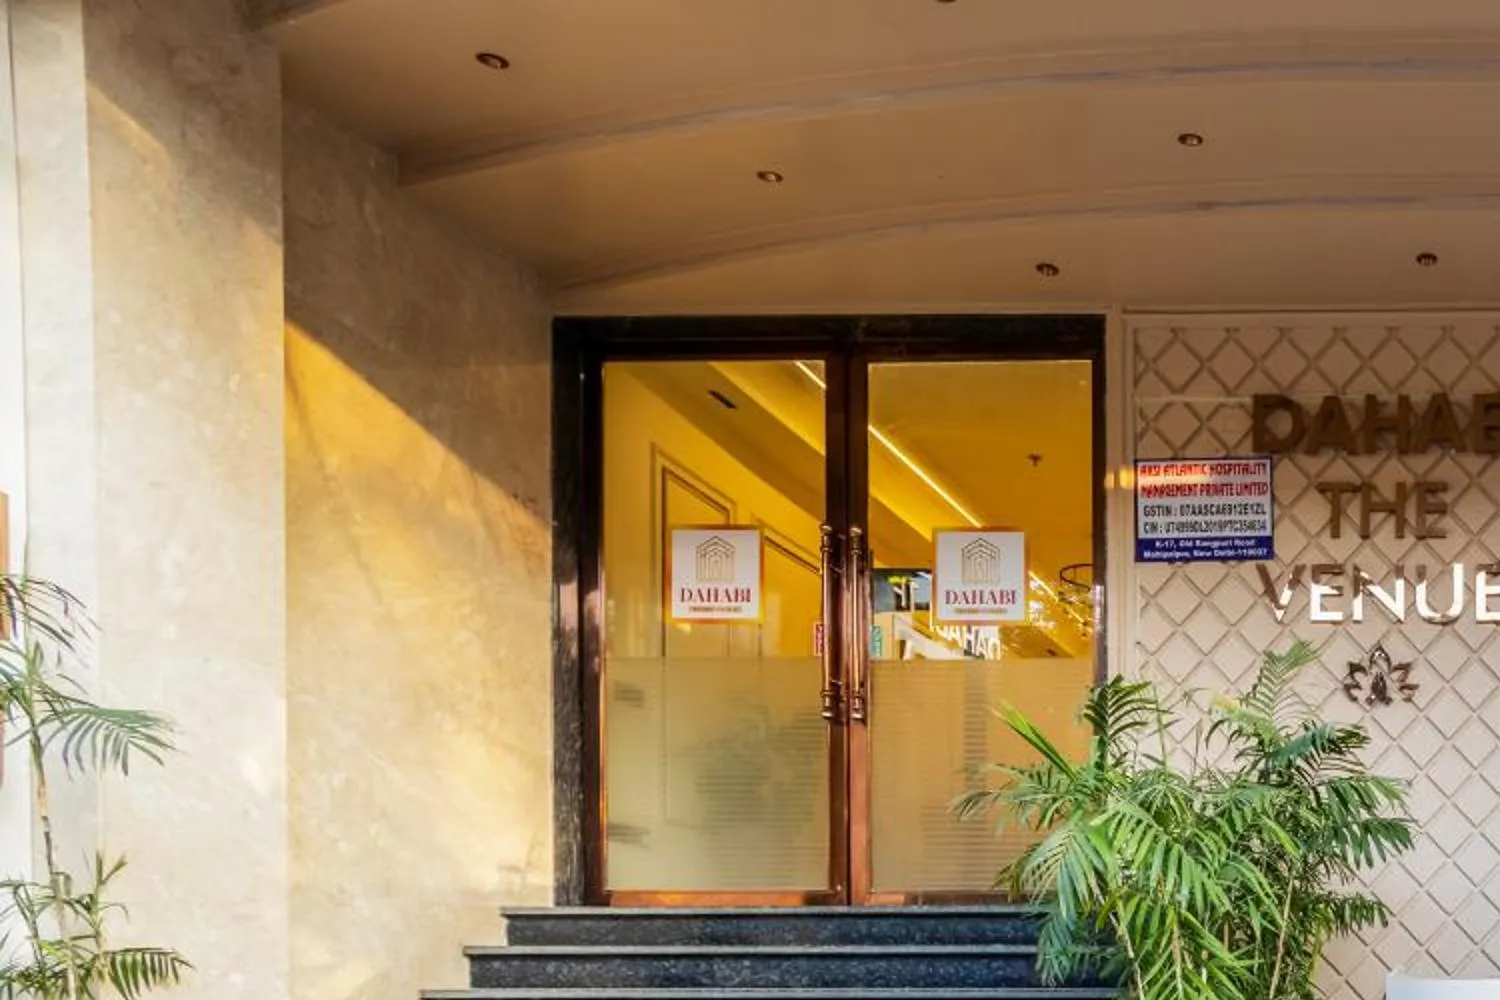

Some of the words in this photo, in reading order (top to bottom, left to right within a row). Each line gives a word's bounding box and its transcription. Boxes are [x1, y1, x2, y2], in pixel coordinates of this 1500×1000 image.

[1209, 462, 1267, 475] HOSPITALITY
[1141, 483, 1199, 498] MANAGEMENT
[1200, 483, 1234, 496] PRIVATE
[1235, 481, 1268, 496] LIMITED
[1315, 481, 1449, 539] THE
[680, 587, 751, 603] DAHABI
[945, 589, 1016, 605] DAHABI
